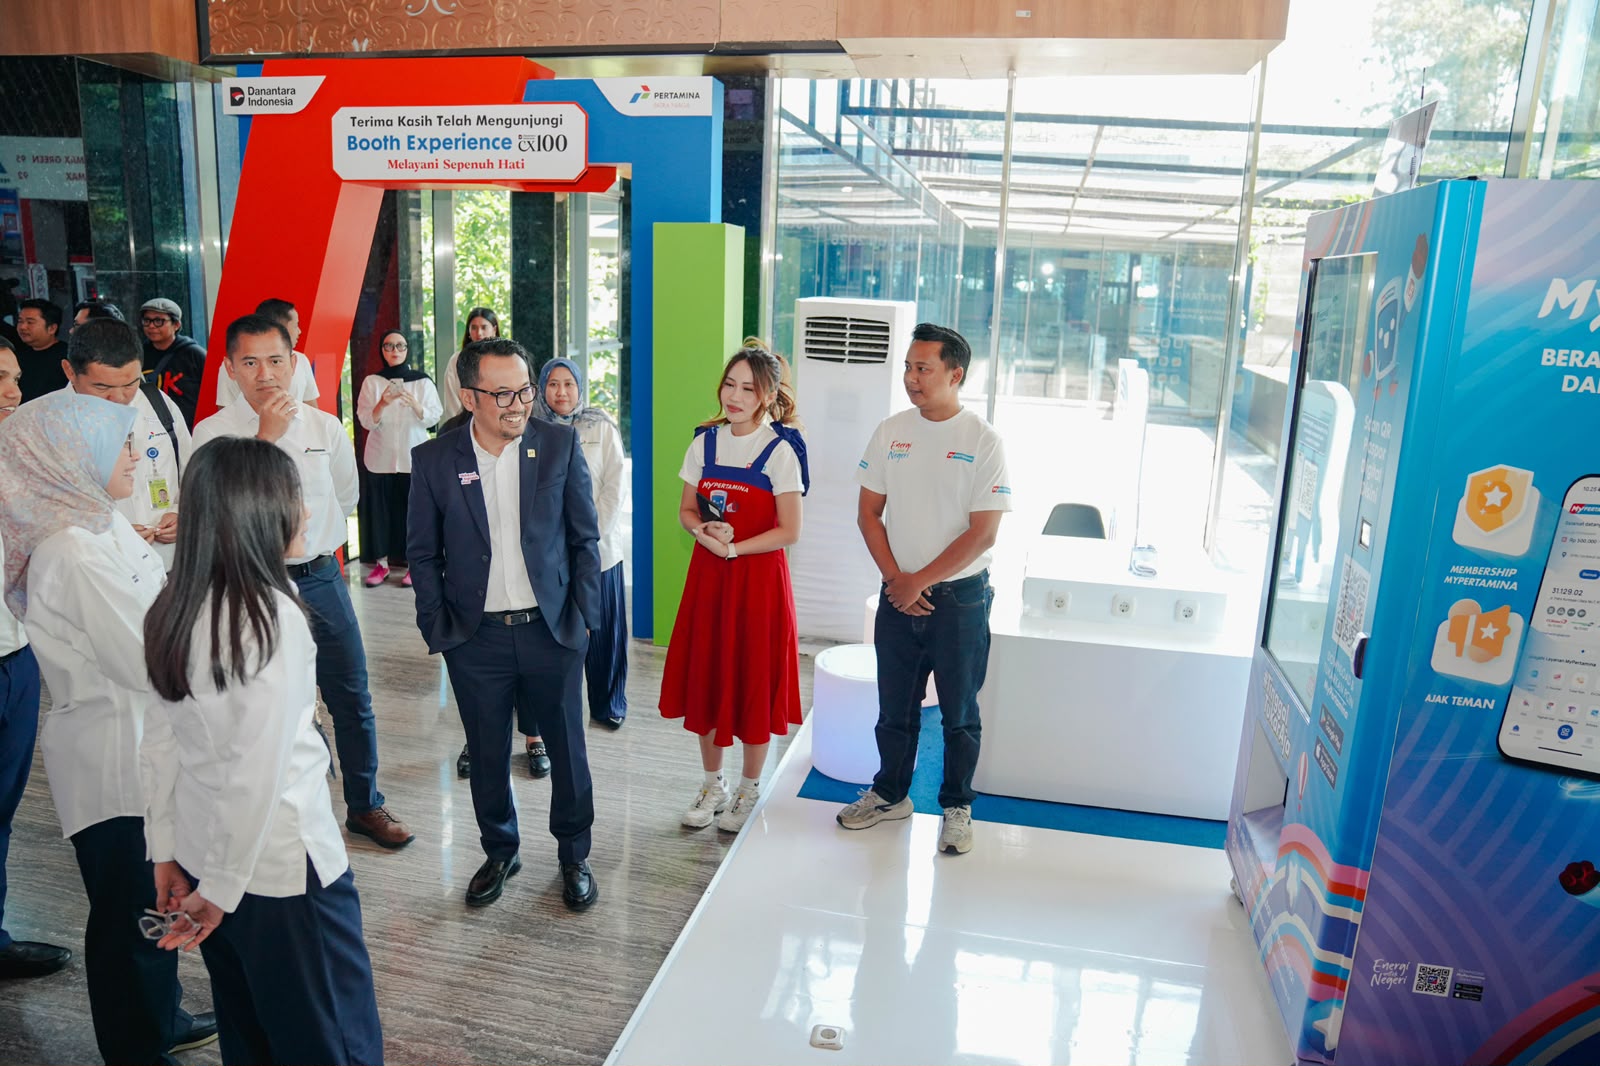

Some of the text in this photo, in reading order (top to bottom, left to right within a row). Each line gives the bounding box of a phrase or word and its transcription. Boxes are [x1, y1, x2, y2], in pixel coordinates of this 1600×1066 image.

[247, 86, 296, 96] Danantara
[248, 97, 293, 106] Indonesia
[350, 114, 563, 129] Terima Kasih Telah Mengunjungi
[347, 134, 401, 151] Booth
[407, 132, 513, 154] Experience
[387, 158, 525, 172] Melayani Sepenuh Hati
[1450, 565, 1518, 577] MEMBERSHIP
[1444, 575, 1518, 591] MYPERTAMINA
[1424, 693, 1496, 710] AJAK TEMAN
[1373, 959, 1410, 976] Energi
[1370, 973, 1407, 990] Negeri
